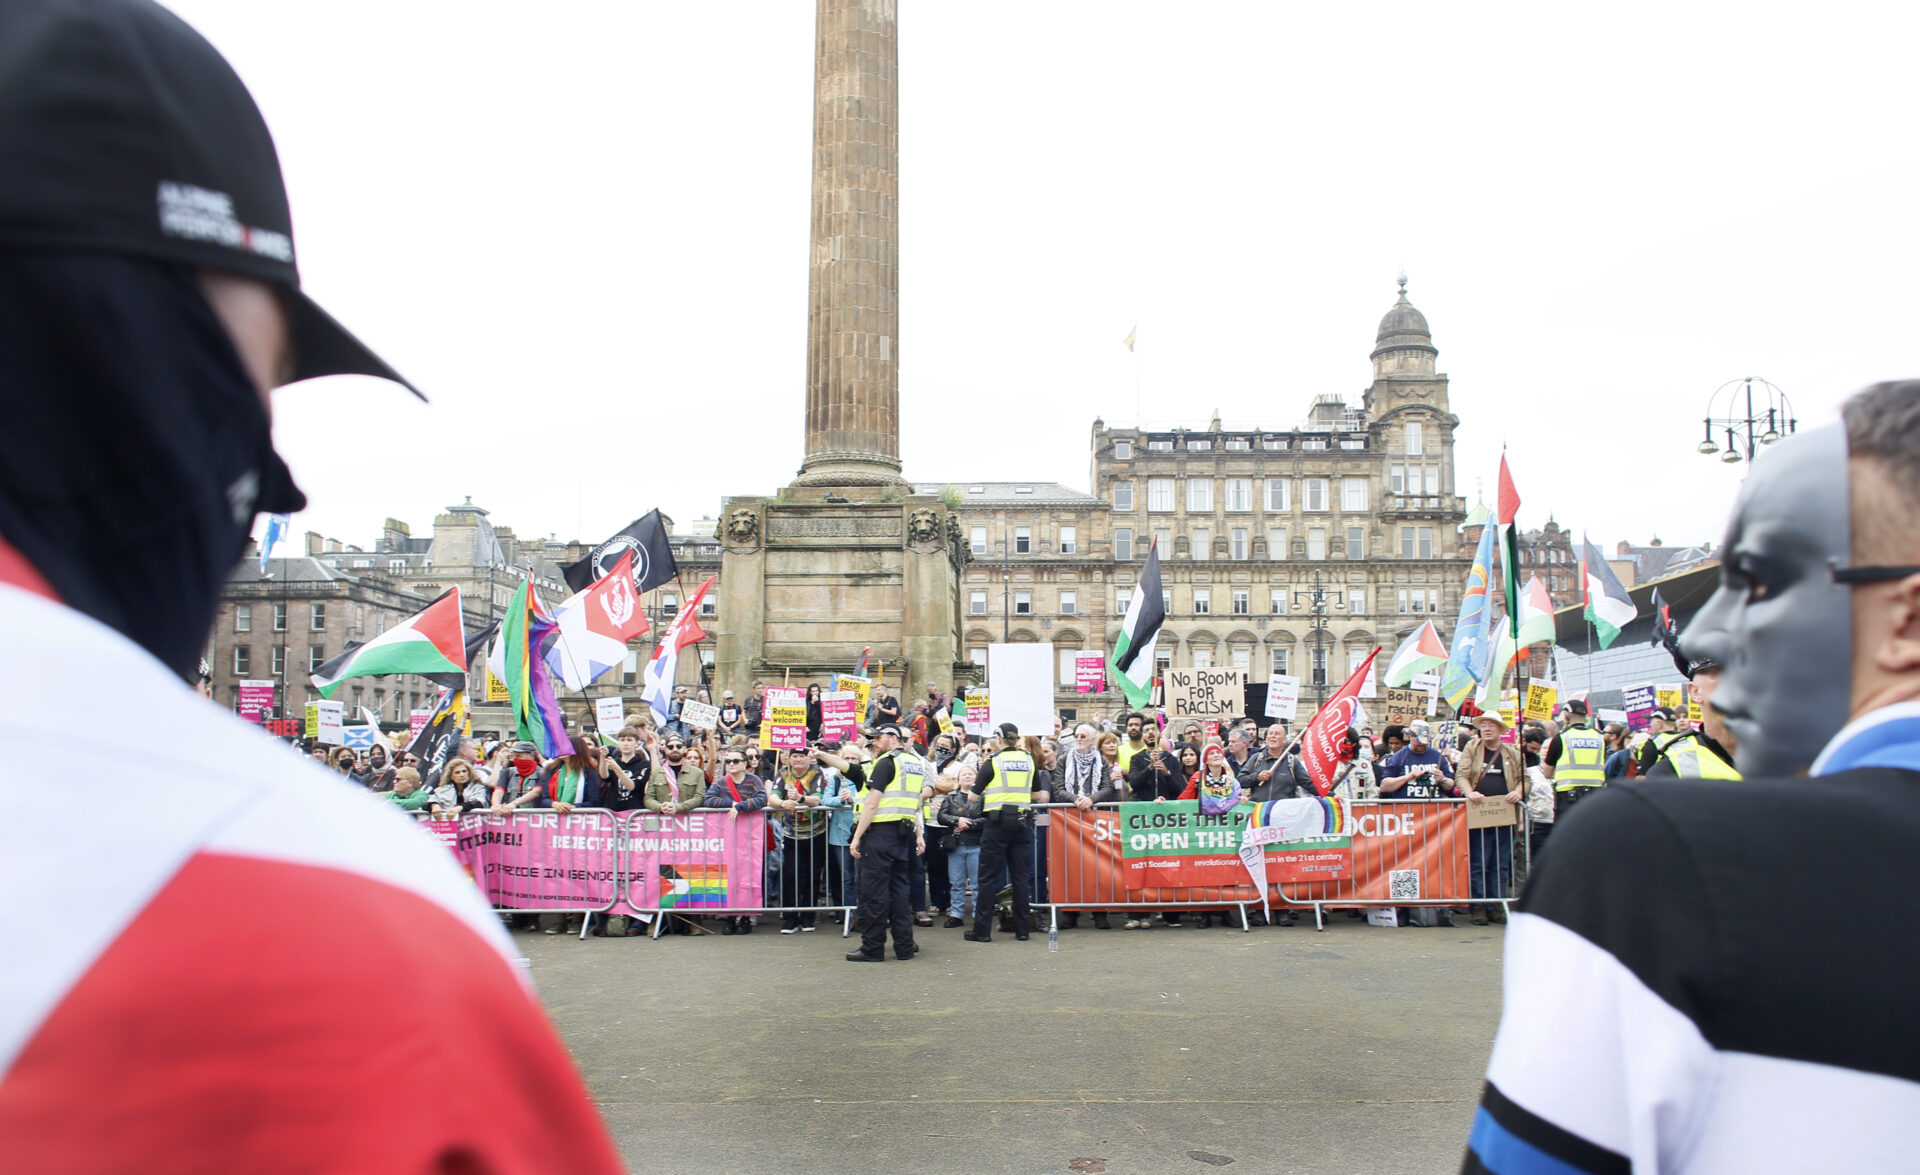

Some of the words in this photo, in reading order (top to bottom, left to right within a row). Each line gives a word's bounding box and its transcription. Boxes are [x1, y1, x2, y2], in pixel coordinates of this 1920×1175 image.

[1189, 686, 1214, 700] FOR
[1532, 685, 1550, 694] STOP
[1387, 690, 1413, 702] Bolt
[1416, 694, 1428, 706] ya
[1531, 692, 1543, 700] THE
[772, 707, 805, 717] Refugees
[1176, 698, 1233, 715] RACISM
[1388, 704, 1427, 716] racists
[1528, 705, 1548, 714] RIGHT
[773, 716, 804, 724] welcome
[823, 711, 856, 720] Refugees
[771, 726, 789, 736] Stop
[790, 727, 803, 735] the
[825, 726, 842, 734] here
[772, 735, 784, 743] far
[784, 735, 802, 745] right
[1570, 738, 1600, 748] POLICE
[1318, 731, 1337, 762] UNION
[1003, 761, 1030, 771] POLICE
[512, 812, 558, 829] FOR
[1129, 812, 1188, 830] CLOSE
[1193, 811, 1228, 828] THE
[474, 830, 523, 847] ISRAEL!
[1252, 826, 1286, 842] LGBT
[552, 835, 602, 851] REJECT
[1130, 831, 1189, 851] OPEN
[1194, 830, 1236, 848] THE
[1131, 861, 1148, 870] rs21
[1148, 859, 1180, 869] Scotland
[1194, 858, 1240, 868] revolutionary
[1286, 855, 1299, 863] the
[1299, 853, 1319, 862] 21st
[1319, 852, 1343, 863] century
[497, 863, 540, 878] PRIDE
[543, 868, 565, 879] IN
[568, 869, 646, 883] GENOCIDE
[1301, 863, 1343, 874] rs21.org.uk
